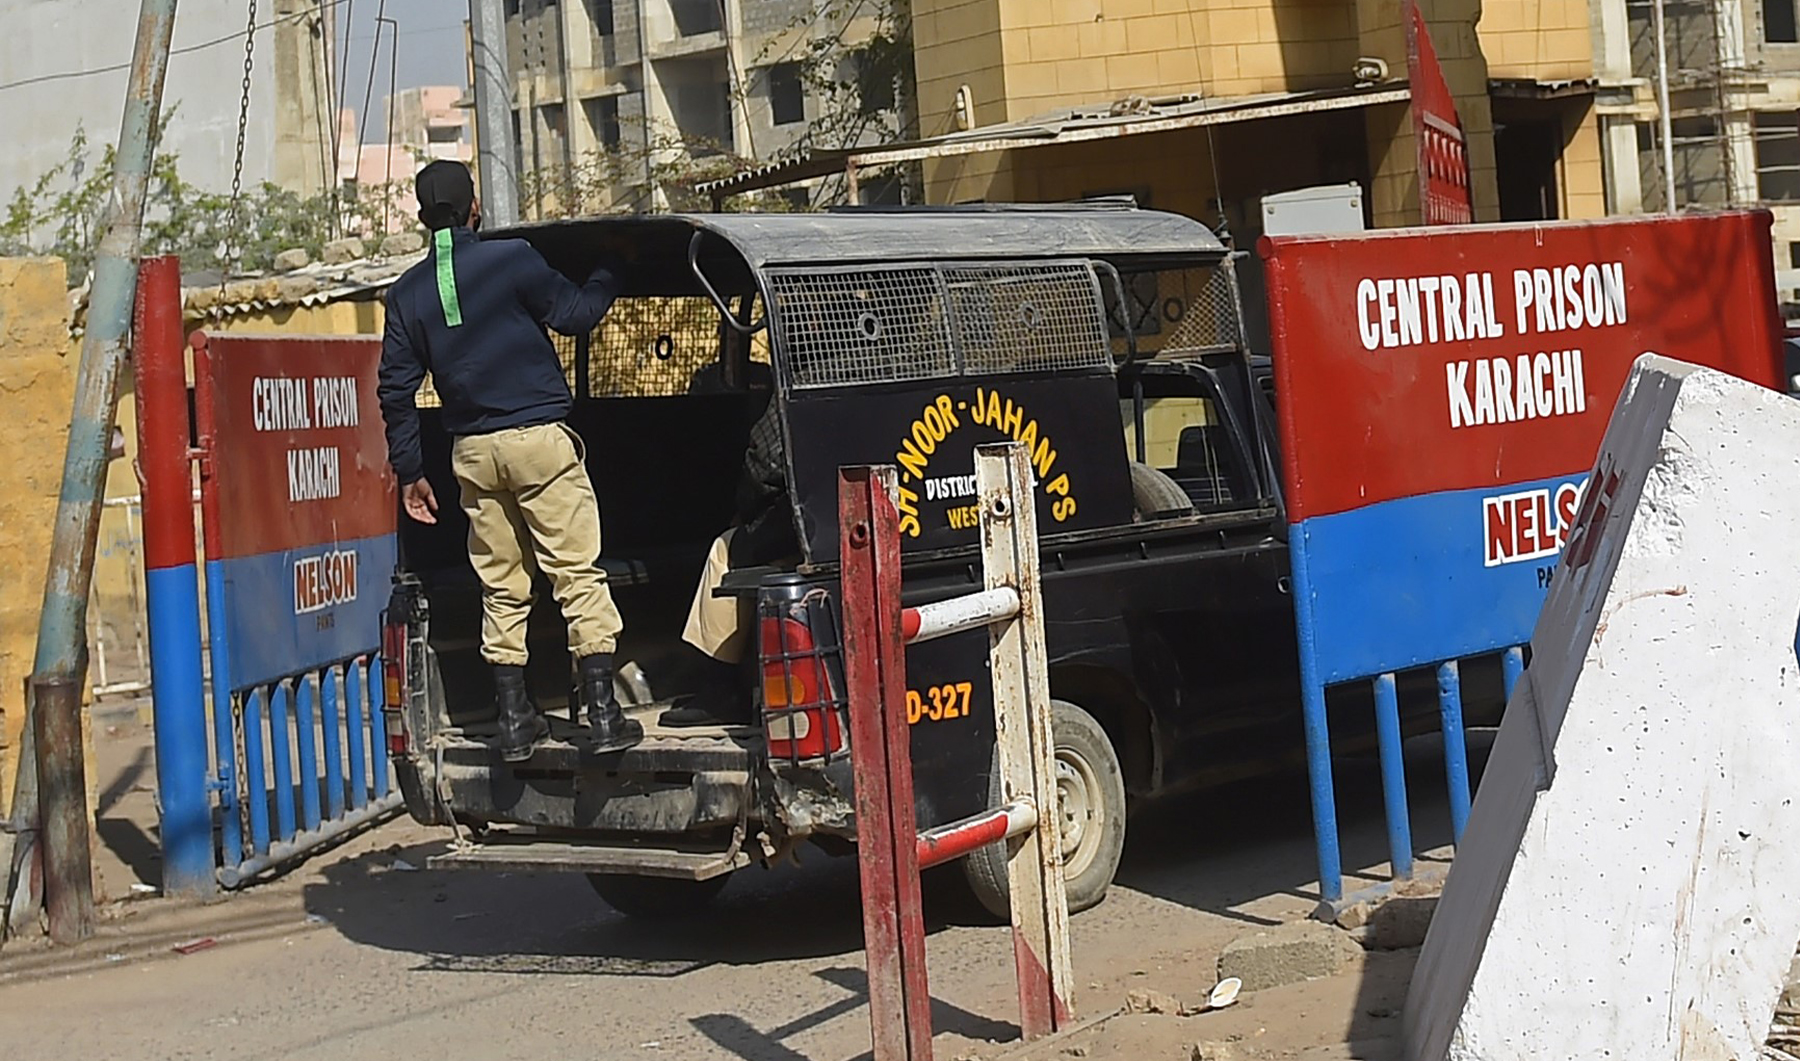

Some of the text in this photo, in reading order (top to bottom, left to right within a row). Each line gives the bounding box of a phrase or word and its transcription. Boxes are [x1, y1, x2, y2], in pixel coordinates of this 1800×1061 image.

[1357, 262, 1627, 350] CENTRAL PRISON
[253, 376, 359, 431] CENTRAL PRISON
[1446, 350, 1586, 428] KARACHI
[287, 447, 340, 501] KARACHI
[1046, 473, 1076, 522] PS
[1483, 477, 1589, 567] NELS
[294, 550, 356, 615] NELSON
